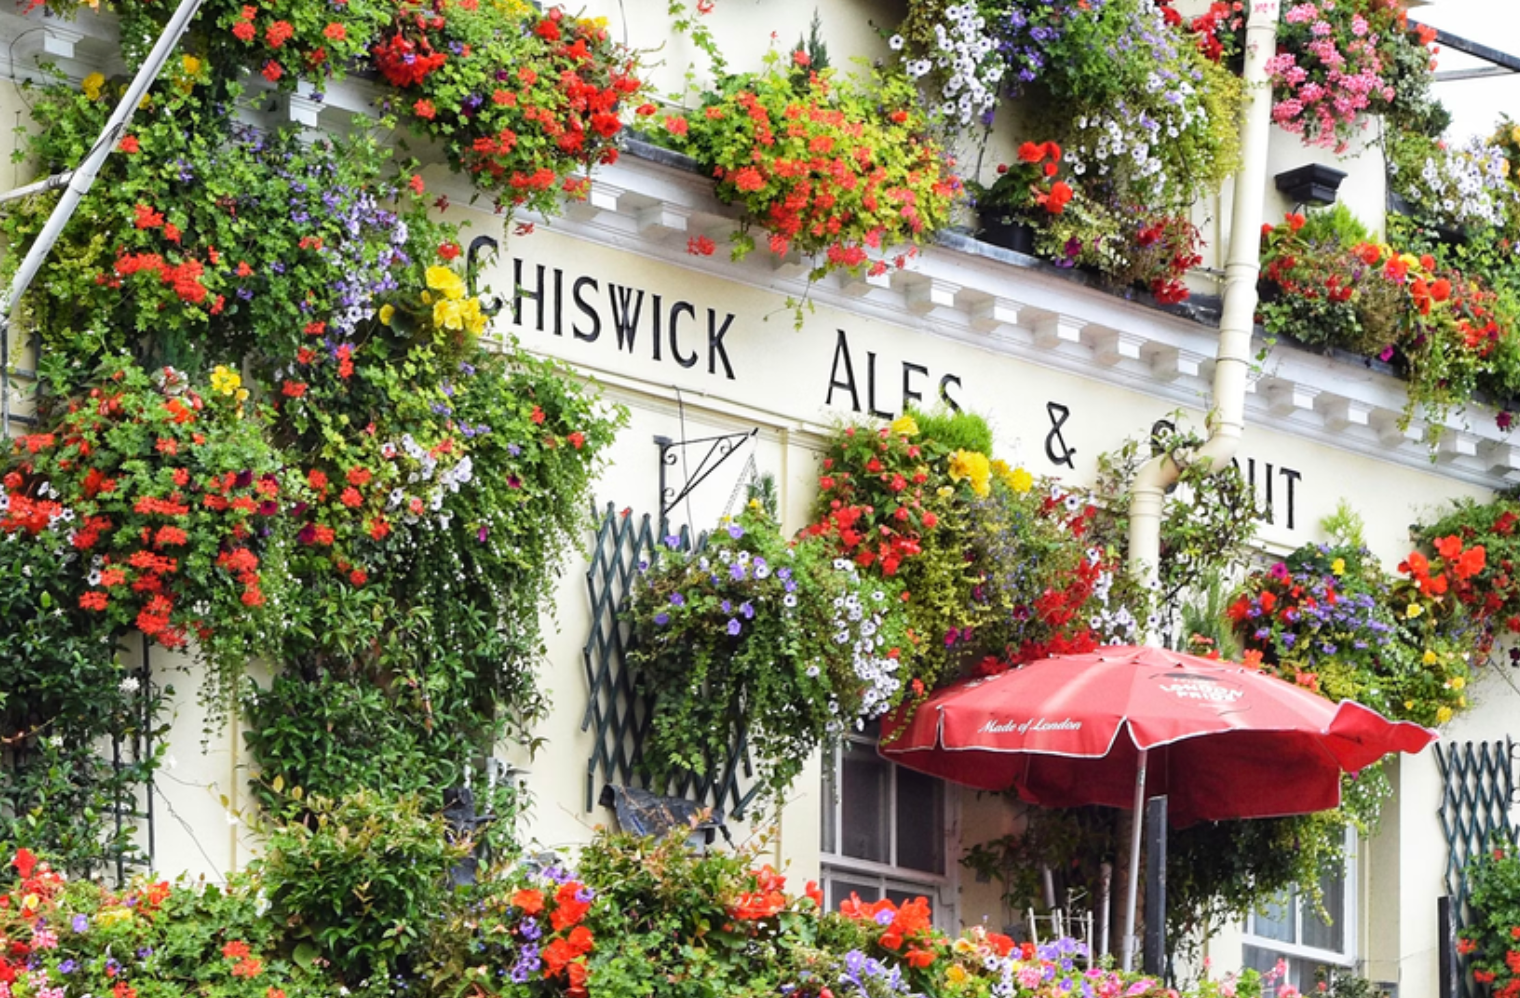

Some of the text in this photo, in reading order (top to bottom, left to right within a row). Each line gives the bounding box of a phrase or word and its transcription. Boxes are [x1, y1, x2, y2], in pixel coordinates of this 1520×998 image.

[467, 234, 736, 380] CHISWICK
[1044, 400, 1077, 470] &
[977, 717, 1082, 735] Made of London
